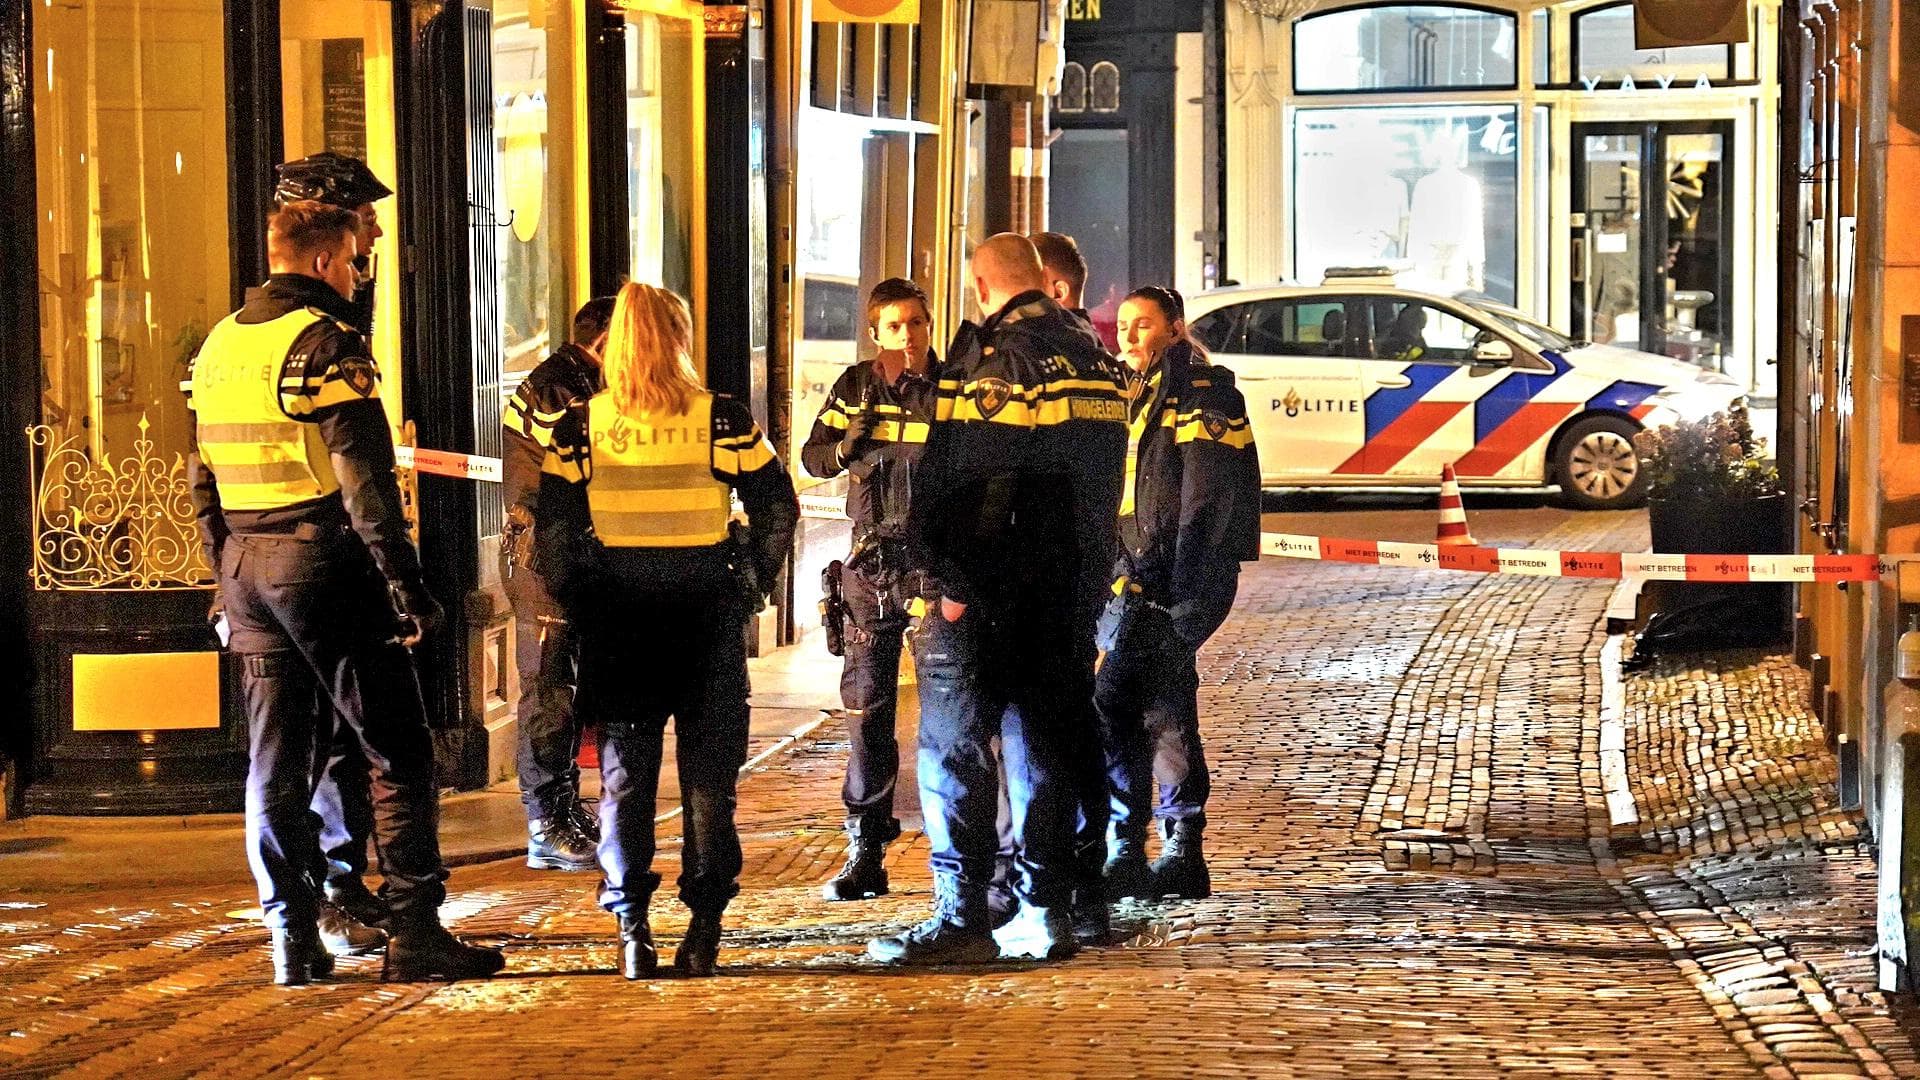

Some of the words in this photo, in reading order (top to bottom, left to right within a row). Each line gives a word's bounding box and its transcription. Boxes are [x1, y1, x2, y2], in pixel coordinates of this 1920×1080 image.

[1580, 72, 1713, 93] YAYA
[1272, 388, 1358, 417] POLITIE
[594, 415, 708, 454] POLITIE
[457, 462, 493, 473] POLITIE
[1275, 539, 1313, 552] POLITIE
[1345, 549, 1362, 557] NIET
[1363, 550, 1401, 559] BETREDEN
[1418, 550, 1457, 563] POLITIE
[1490, 558, 1507, 566] NIET
[1508, 559, 1547, 568] BETREDEN
[1564, 557, 1604, 570] POLITIE
[1639, 564, 1655, 572] NIET
[1657, 564, 1697, 573] BETREDEN
[1715, 560, 1756, 574] POLITIE
[1811, 566, 1853, 574] BETREDEN
[1871, 560, 1897, 574] POLI
